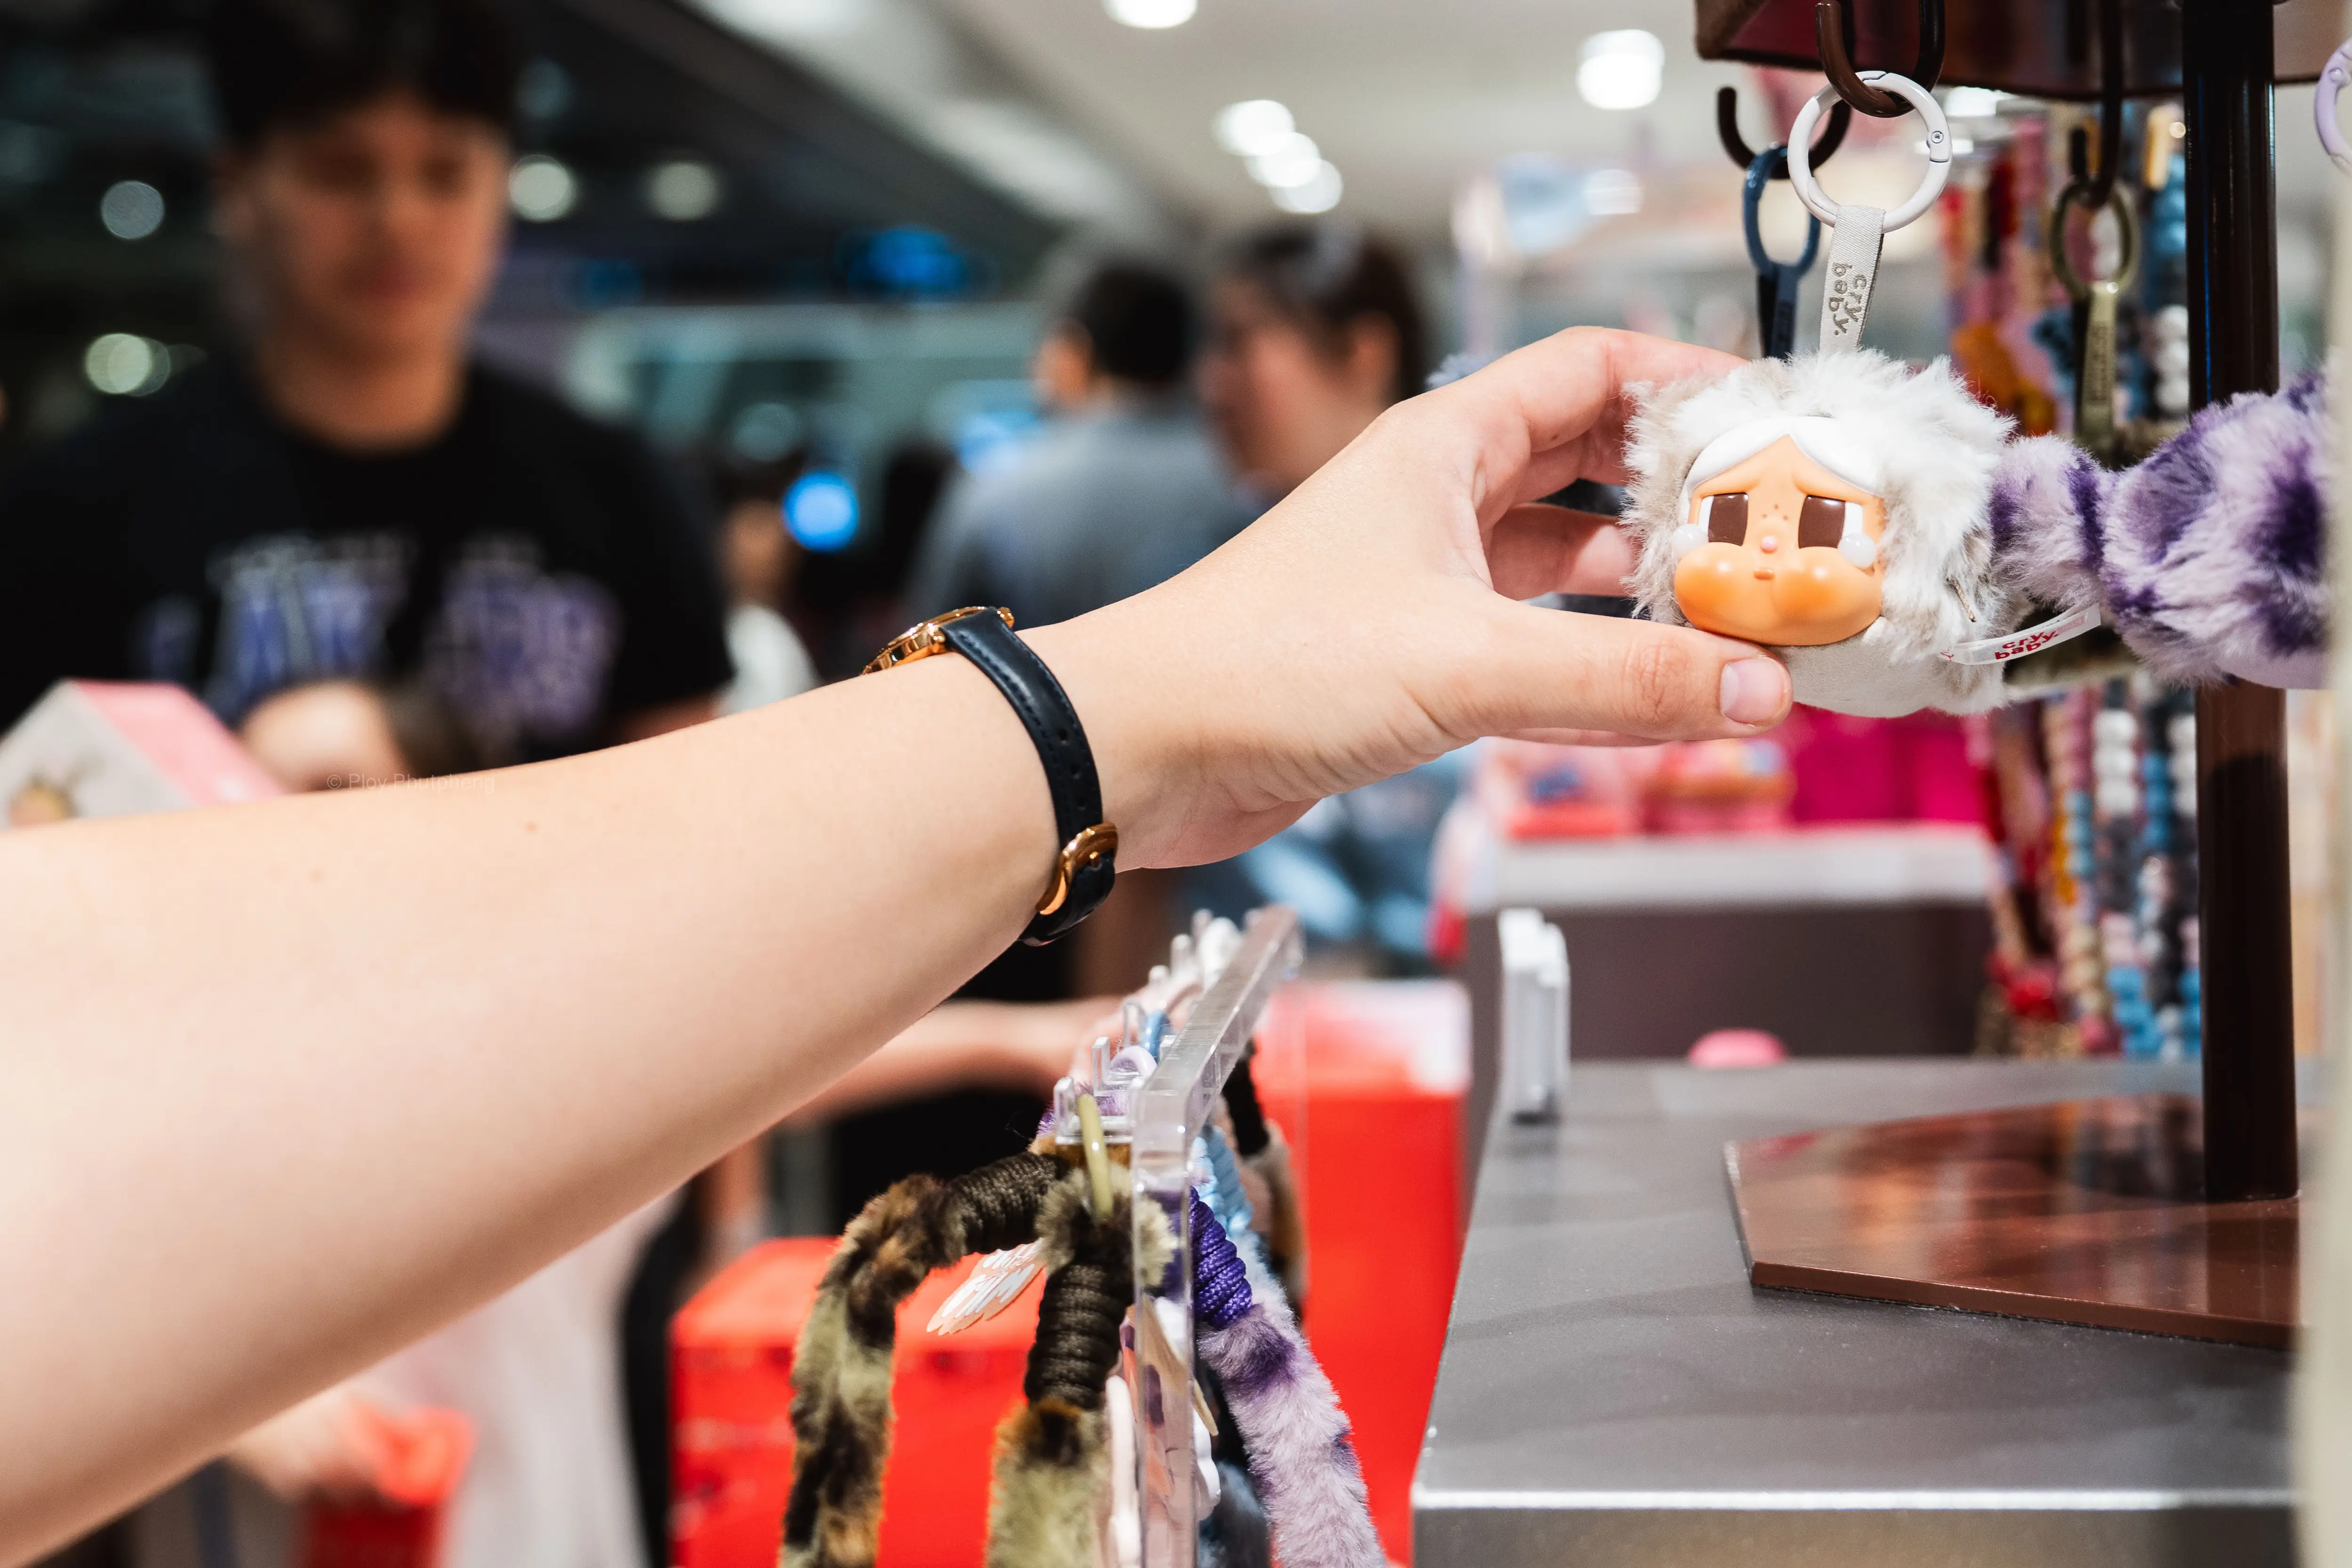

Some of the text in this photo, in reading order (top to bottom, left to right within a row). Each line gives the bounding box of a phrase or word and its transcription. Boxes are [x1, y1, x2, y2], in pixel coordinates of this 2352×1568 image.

[1828, 263, 1852, 335] baby.
[1843, 274, 1867, 323] cry
[1994, 631, 2059, 660] baby.
[2002, 631, 2044, 649] cry
